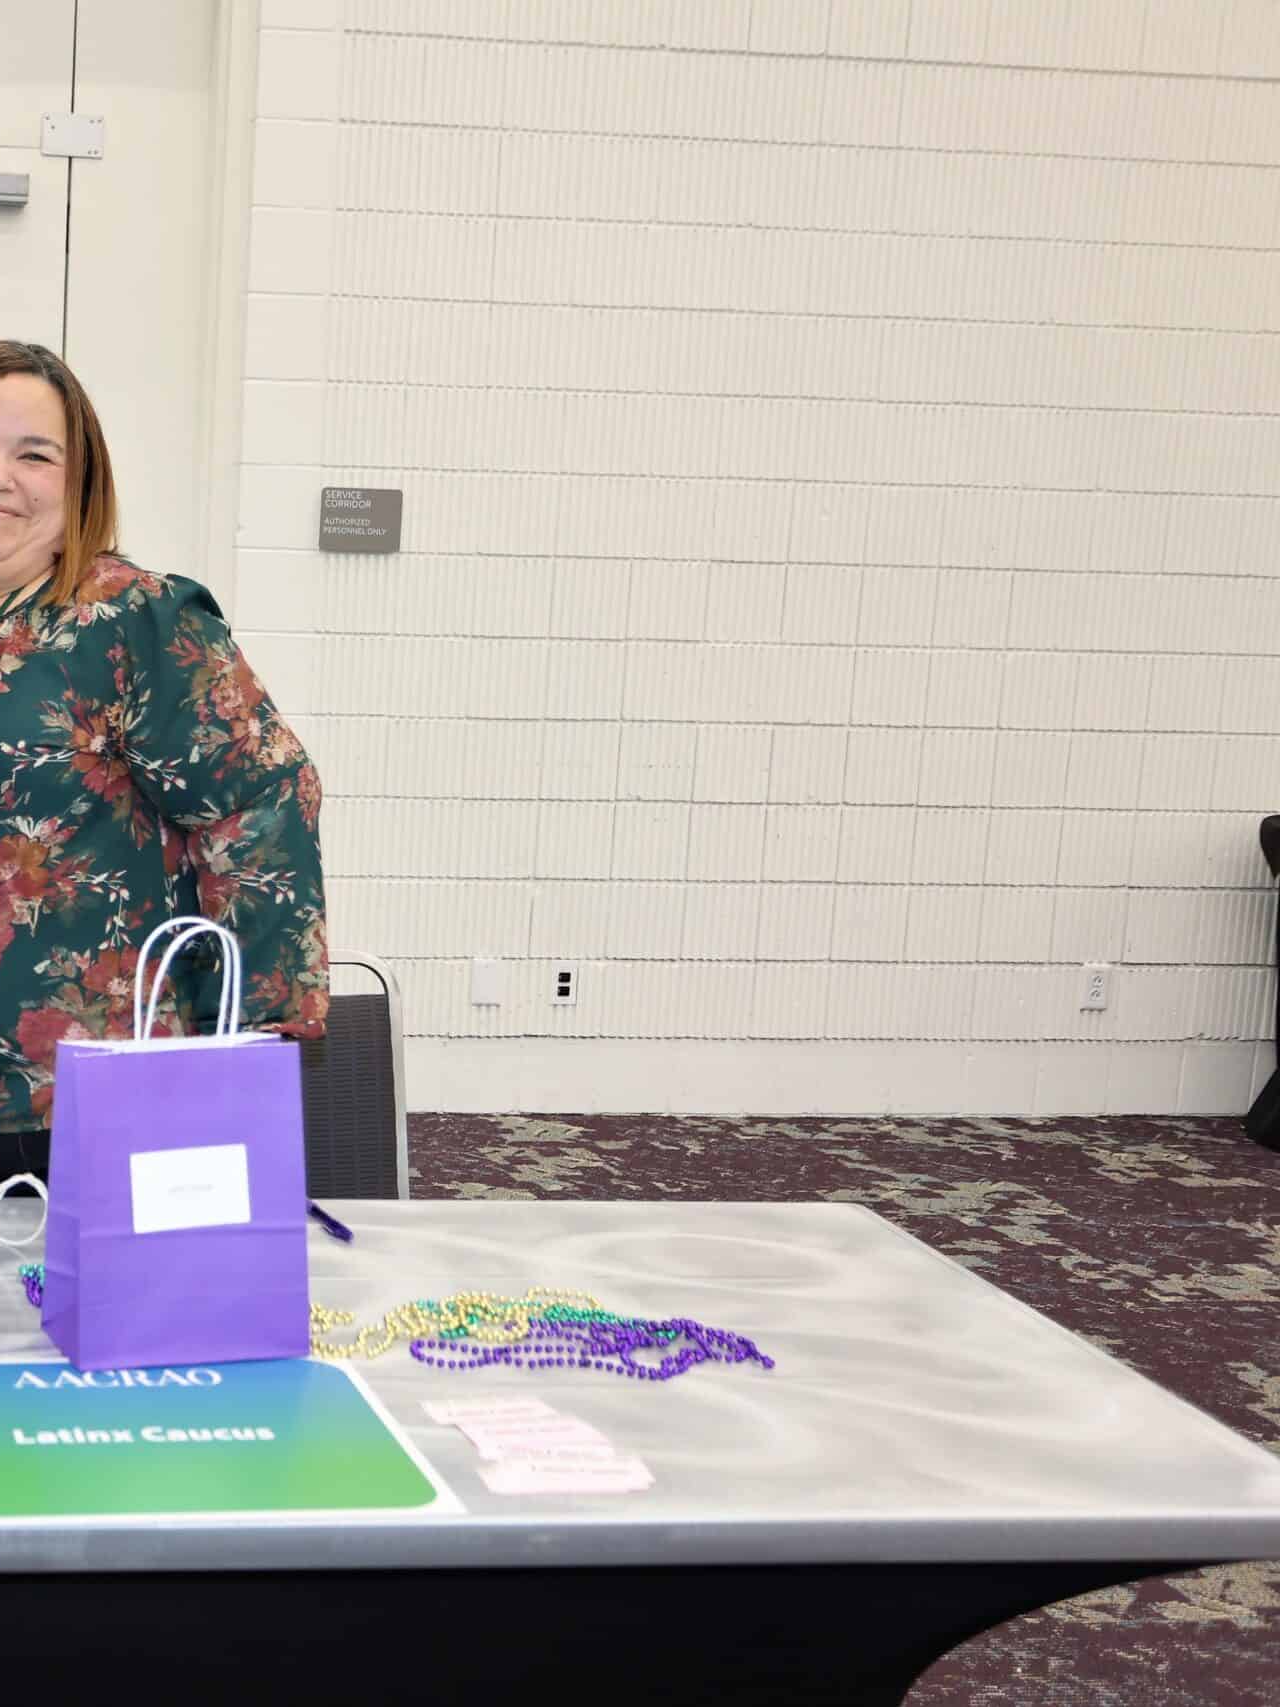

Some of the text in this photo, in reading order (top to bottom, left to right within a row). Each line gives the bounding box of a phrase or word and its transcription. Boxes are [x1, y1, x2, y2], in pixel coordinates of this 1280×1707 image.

[325, 490, 363, 499] SERVICE
[325, 500, 372, 509] CORRIDOR
[325, 518, 371, 527] AUTHORIZED
[323, 527, 386, 536] PERSONNEL ONLY
[14, 1367, 222, 1389] AACRAO
[13, 1425, 275, 1445] Latinx Caucus
